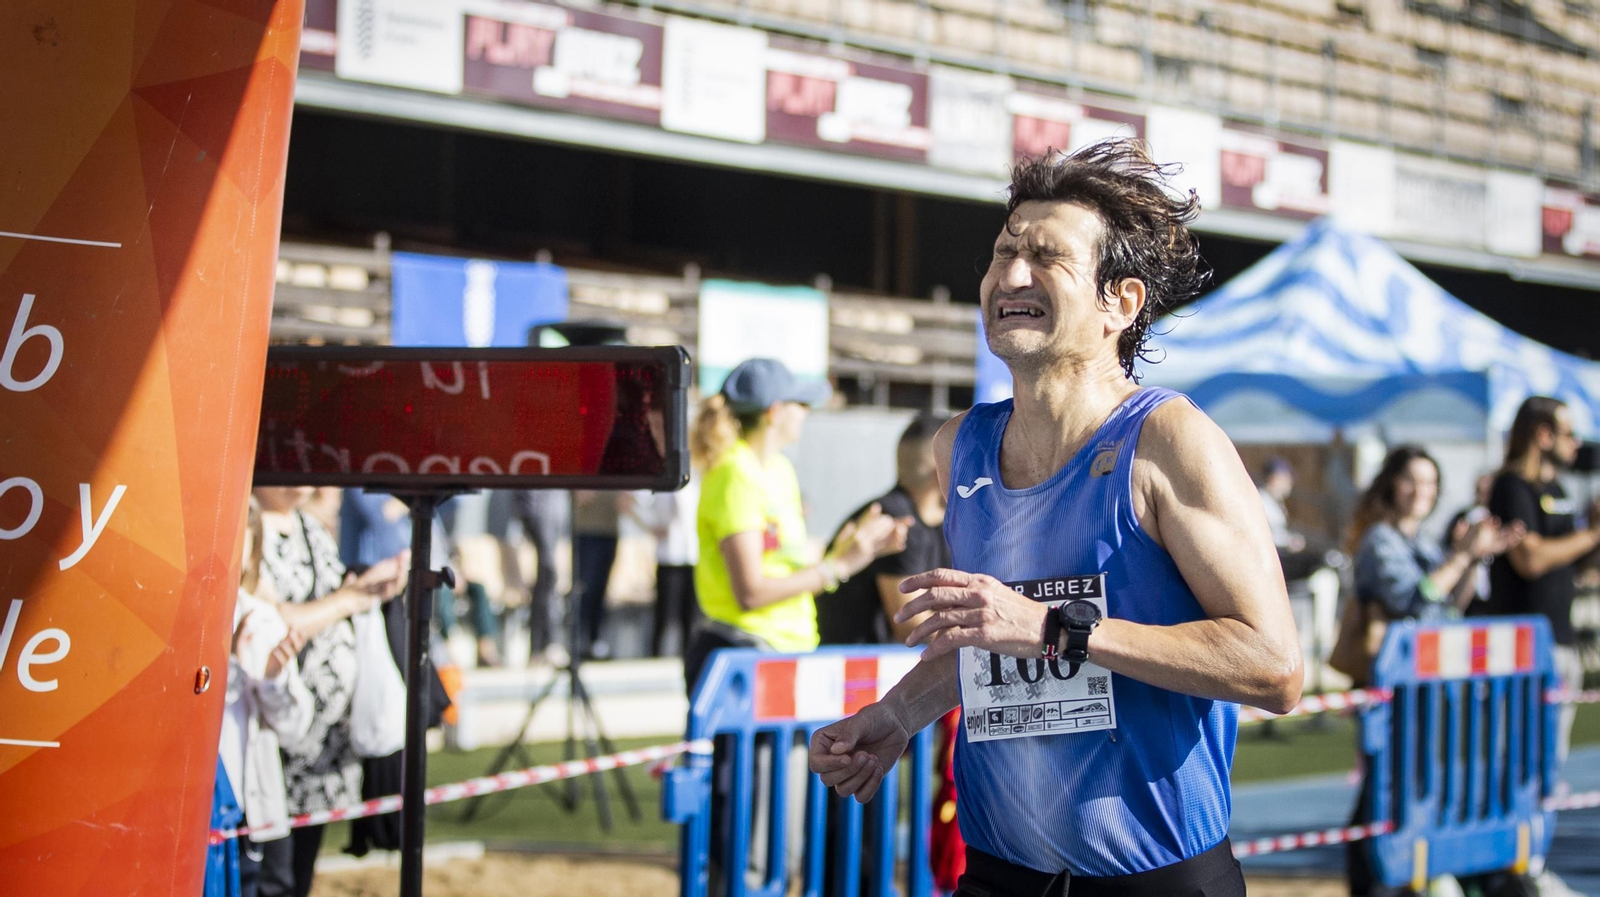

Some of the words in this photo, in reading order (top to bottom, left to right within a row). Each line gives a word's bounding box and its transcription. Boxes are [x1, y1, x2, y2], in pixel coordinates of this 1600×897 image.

[58, 483, 128, 571] y
[1033, 578, 1095, 598] JEREZ
[966, 707, 988, 735] enjoy!
